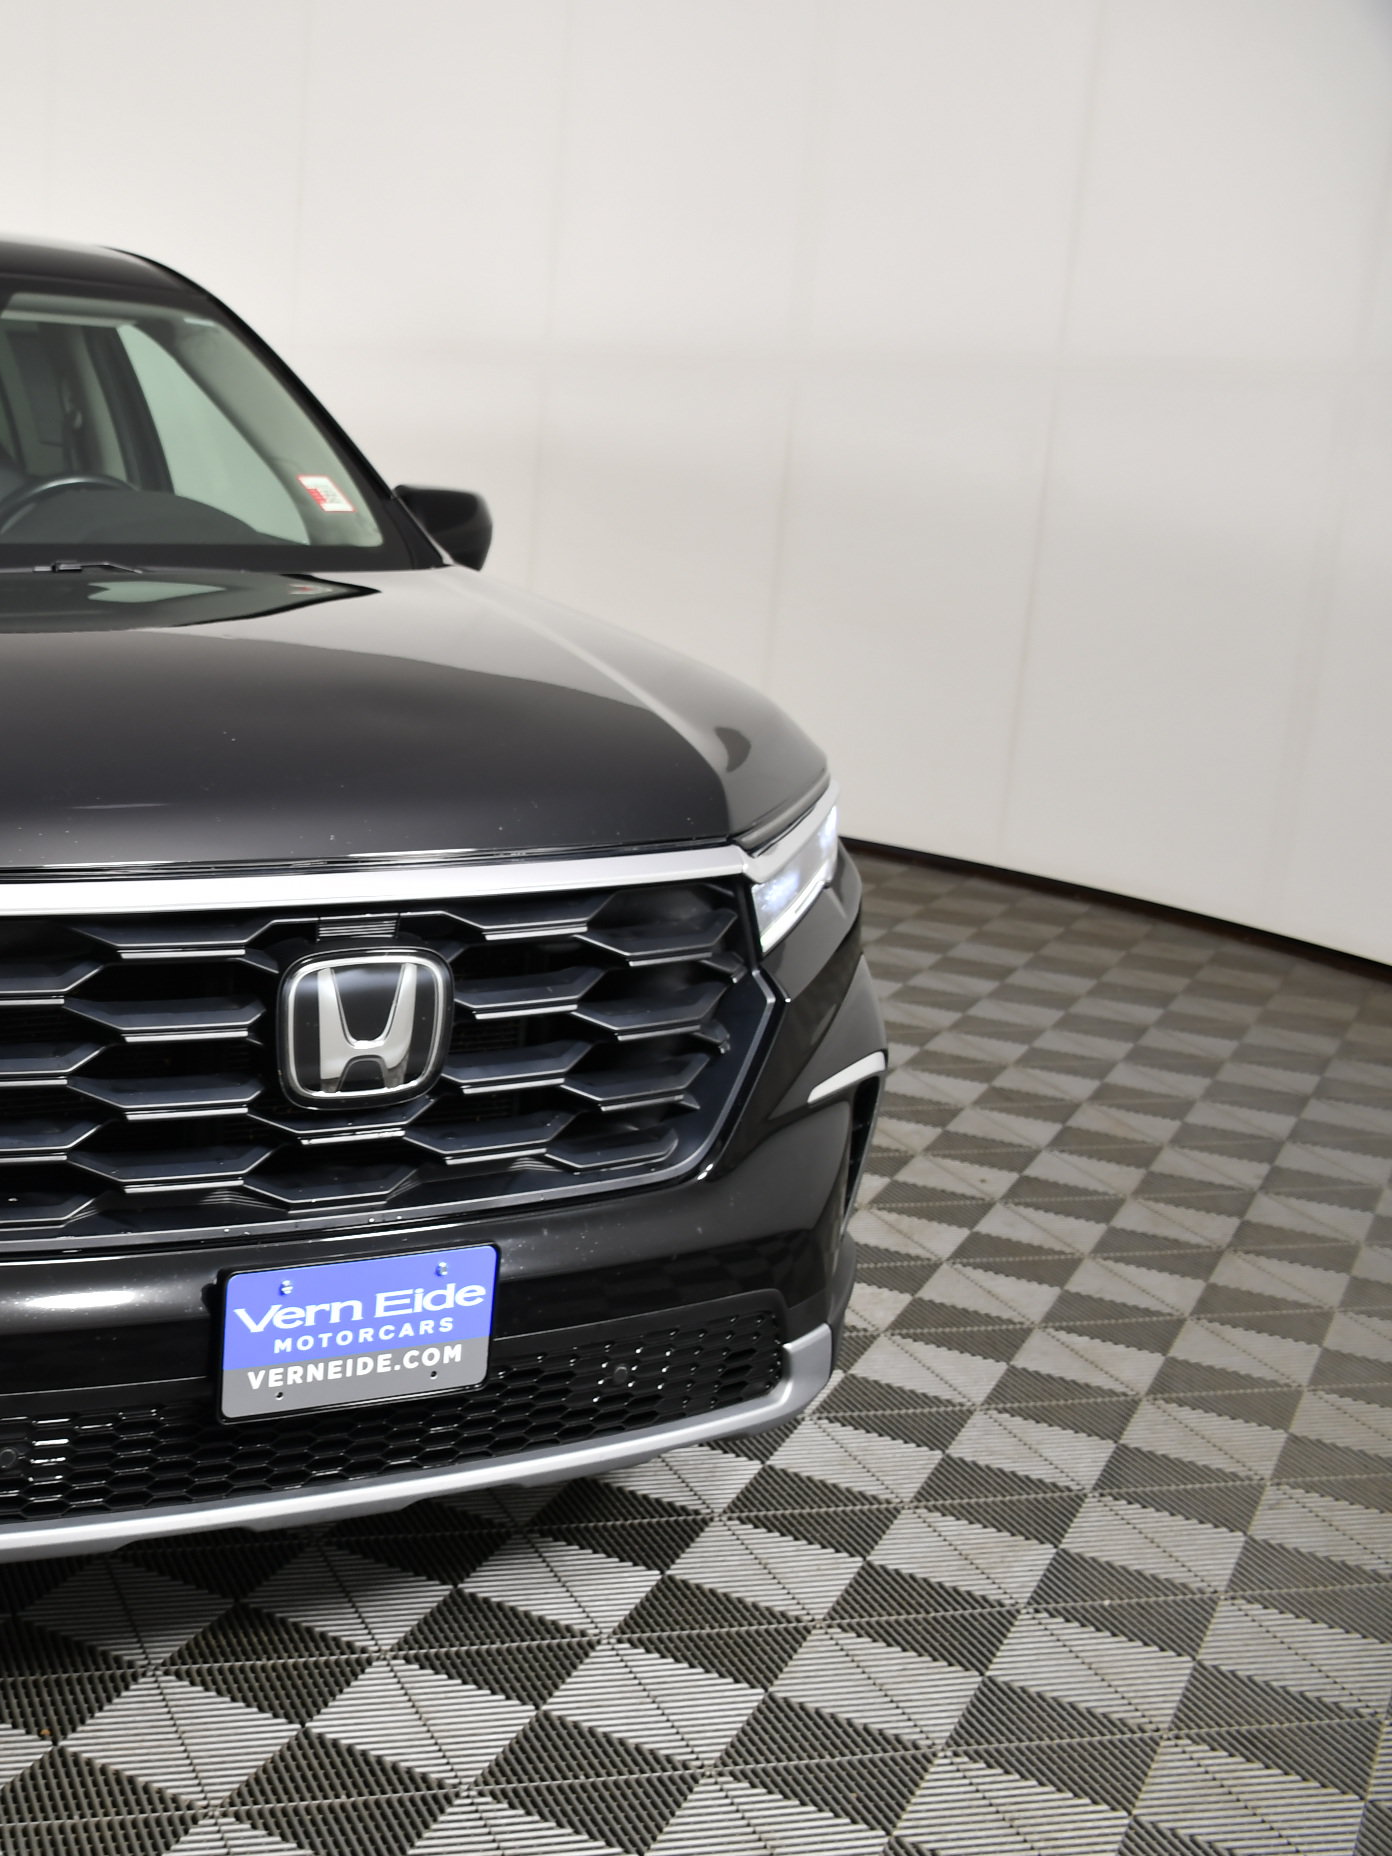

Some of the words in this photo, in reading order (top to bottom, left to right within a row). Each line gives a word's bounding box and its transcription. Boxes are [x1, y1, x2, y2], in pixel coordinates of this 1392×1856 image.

[233, 1299, 363, 1333] Vern
[374, 1283, 487, 1318] Eide
[273, 1317, 454, 1354] MOTORCARS
[247, 1344, 463, 1390] VERNEIDE.COM
